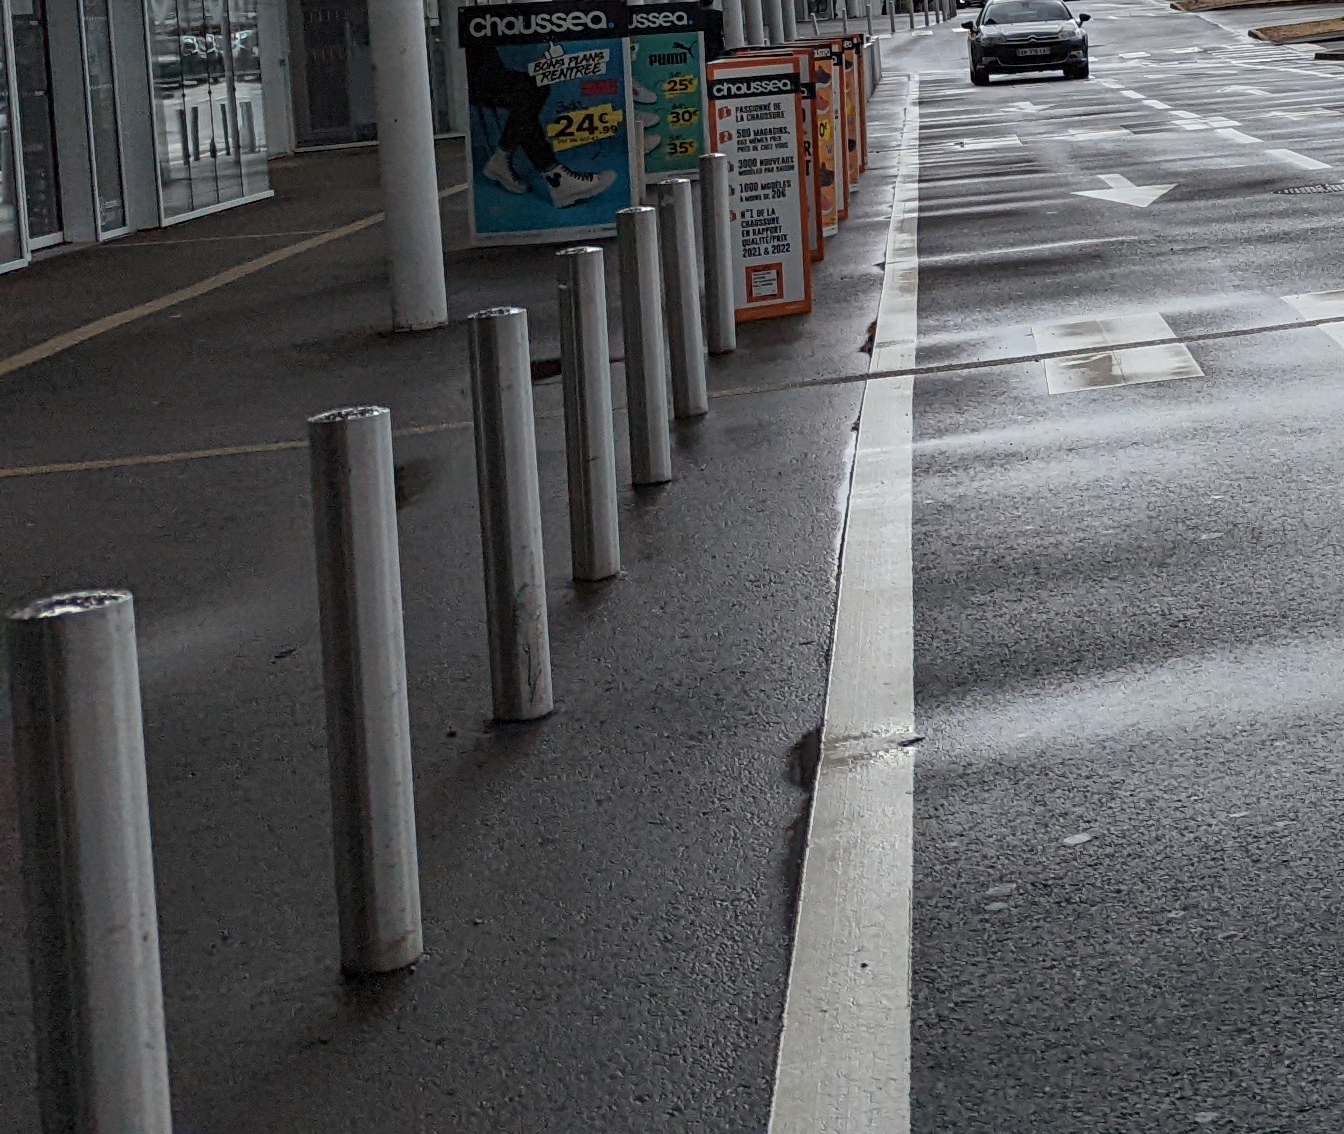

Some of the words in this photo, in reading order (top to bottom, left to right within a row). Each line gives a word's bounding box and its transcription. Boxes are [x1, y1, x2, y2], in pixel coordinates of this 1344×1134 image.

[567, 51, 605, 66] PLANS
[648, 52, 688, 66] PUMA
[739, 182, 759, 194] 1000
[766, 207, 776, 217] LA
[741, 228, 751, 238] EN
[742, 247, 763, 258] 2021
[763, 247, 770, 256] &
[771, 242, 791, 255] 2022
